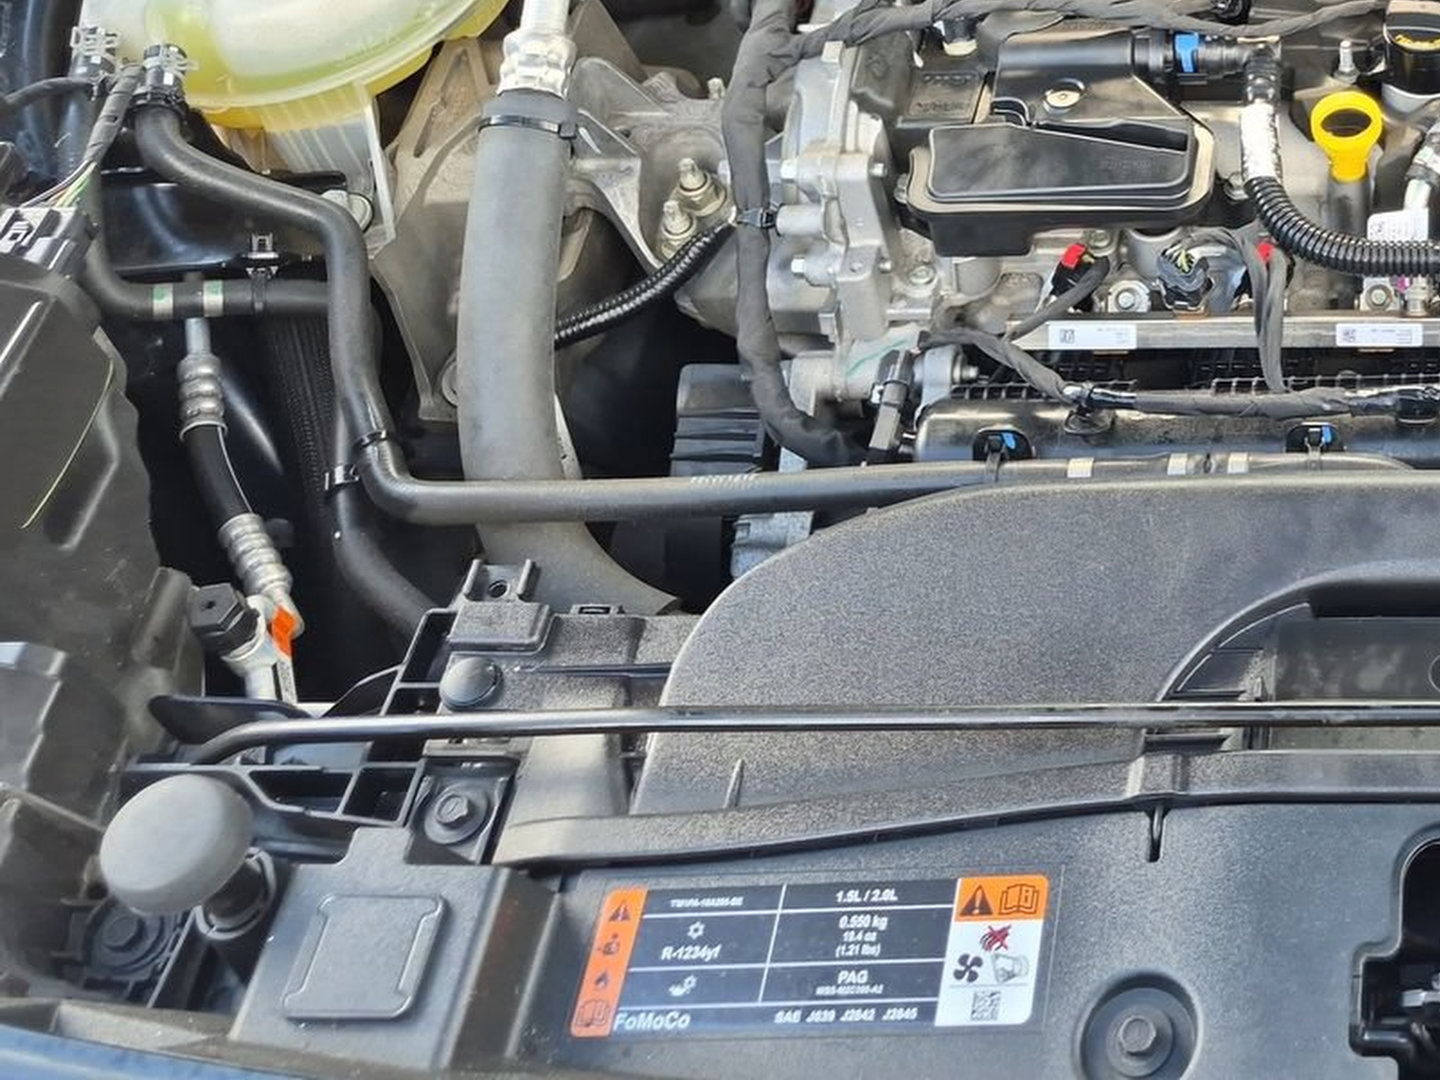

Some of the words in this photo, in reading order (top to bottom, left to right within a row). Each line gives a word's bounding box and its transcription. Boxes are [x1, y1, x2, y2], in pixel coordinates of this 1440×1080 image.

[836, 889, 861, 903] 1.5L
[870, 888, 898, 902] 2.0L
[872, 914, 888, 931] kg
[661, 944, 722, 962] R-1234yf
[837, 970, 868, 984] PAG
[613, 1010, 691, 1031] FoMoCo
